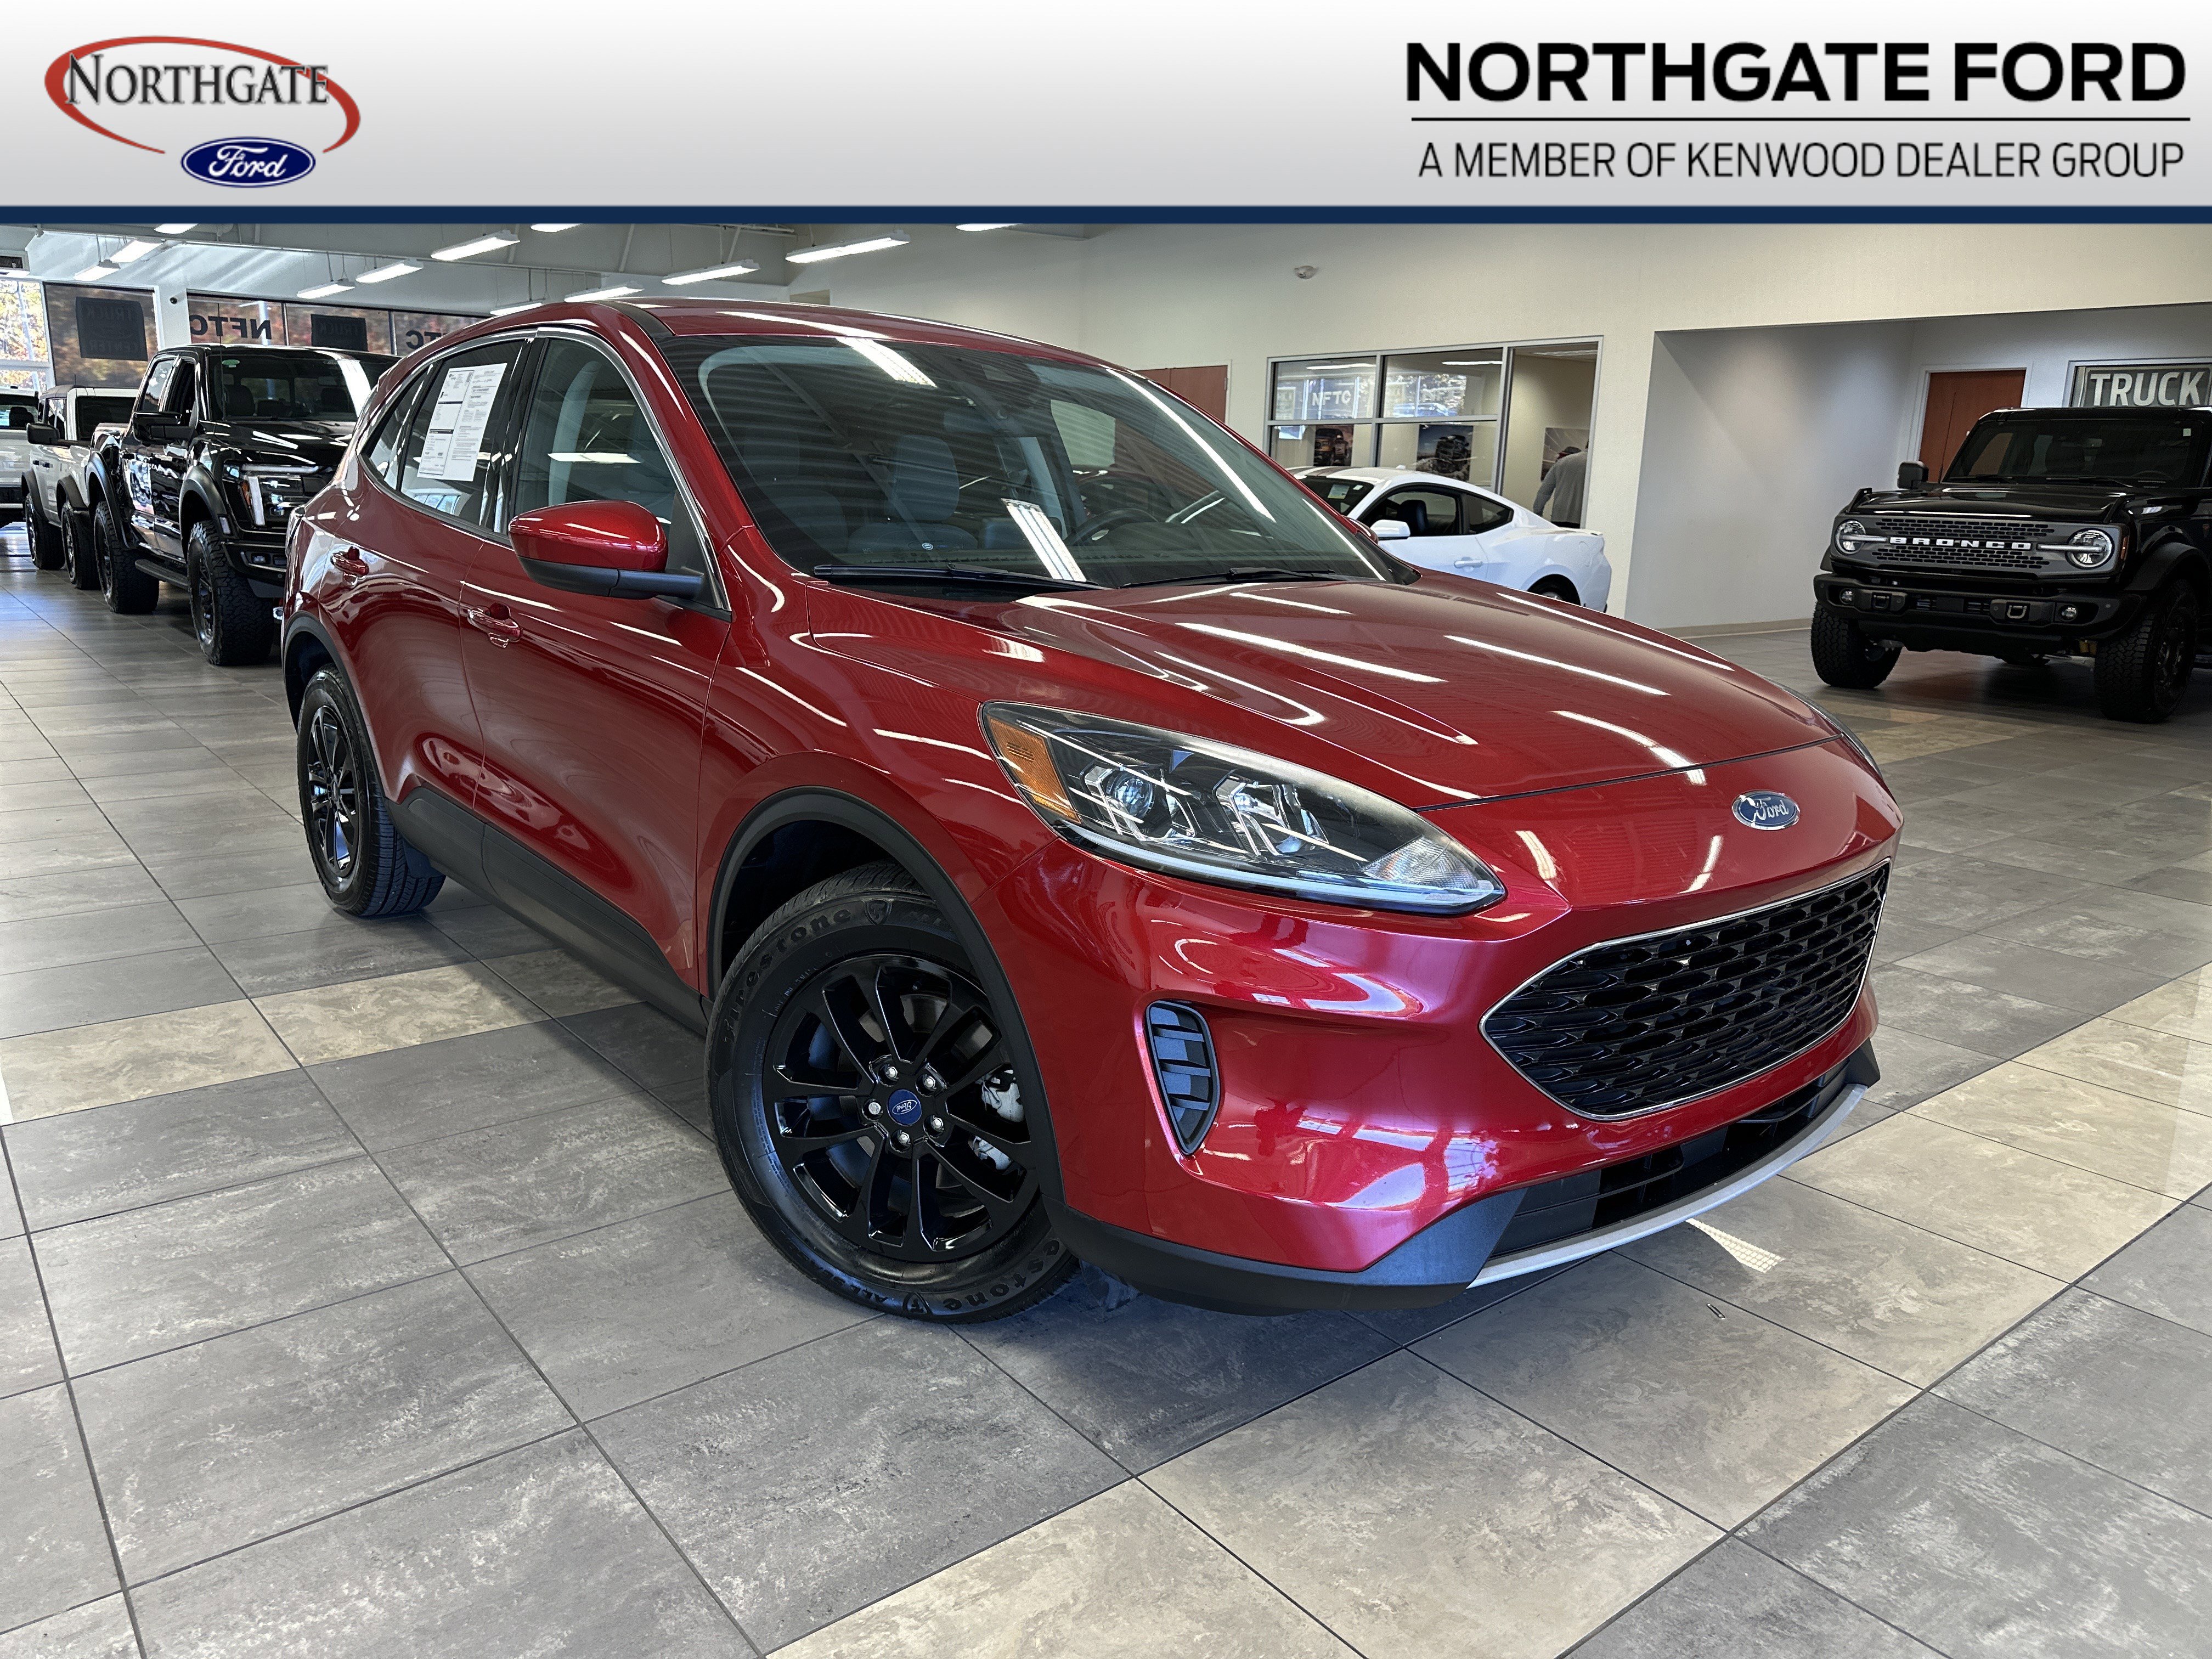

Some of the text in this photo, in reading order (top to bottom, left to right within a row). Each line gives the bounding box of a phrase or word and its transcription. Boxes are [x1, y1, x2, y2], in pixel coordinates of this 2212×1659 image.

[2090, 370, 2206, 407] TRUCK
[1889, 537, 2032, 550] BRONCO
[1752, 796, 1790, 821] Ford
[896, 1101, 912, 1113] Ford
